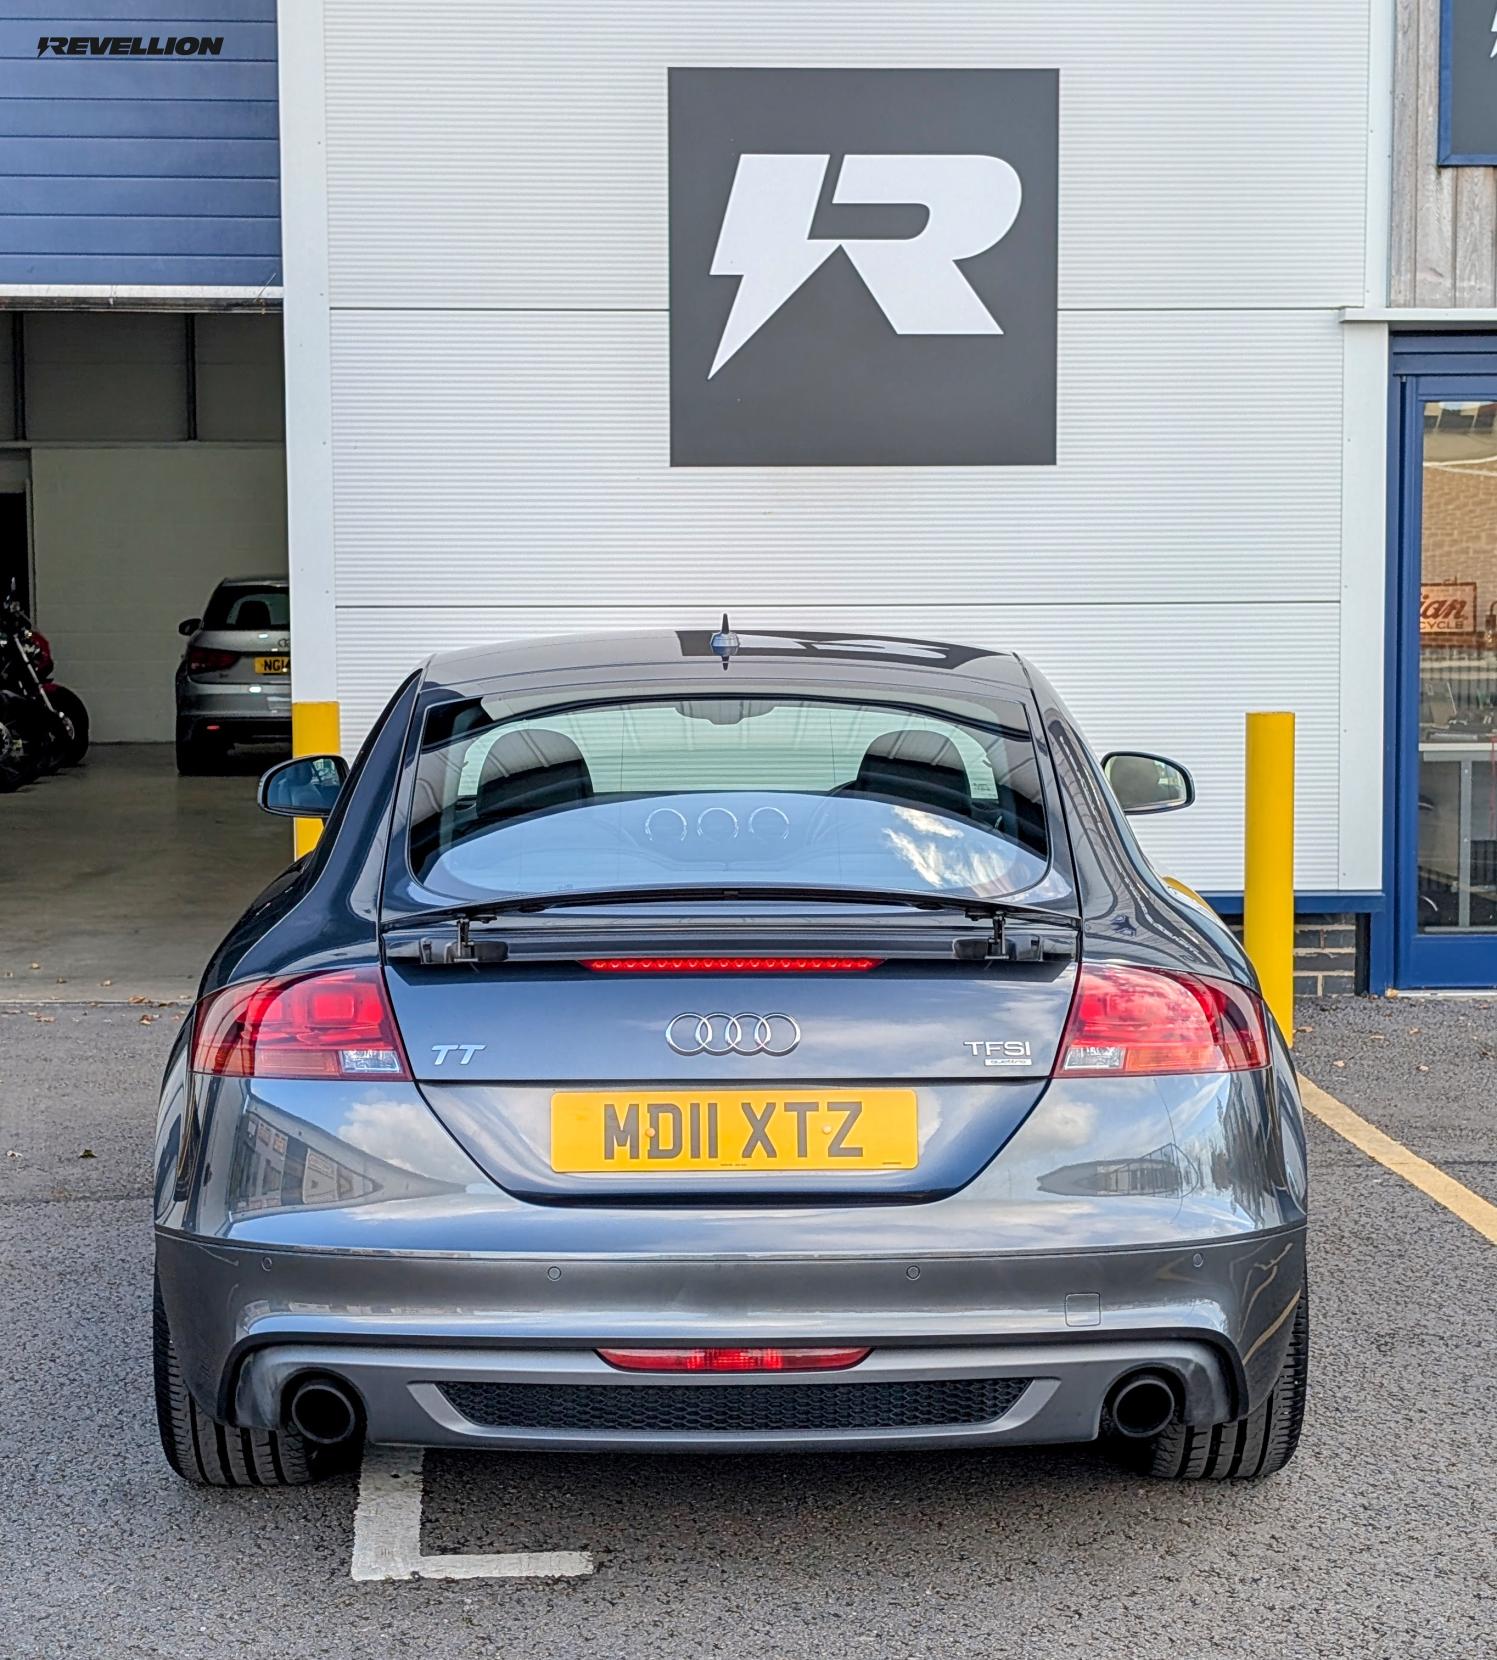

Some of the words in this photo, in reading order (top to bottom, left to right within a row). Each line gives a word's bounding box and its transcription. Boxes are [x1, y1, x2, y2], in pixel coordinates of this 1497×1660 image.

[431, 1044, 487, 1066] TT
[963, 1041, 1031, 1056] TFSI
[604, 1102, 718, 1160] MD11
[741, 1101, 864, 1158] XTZ
